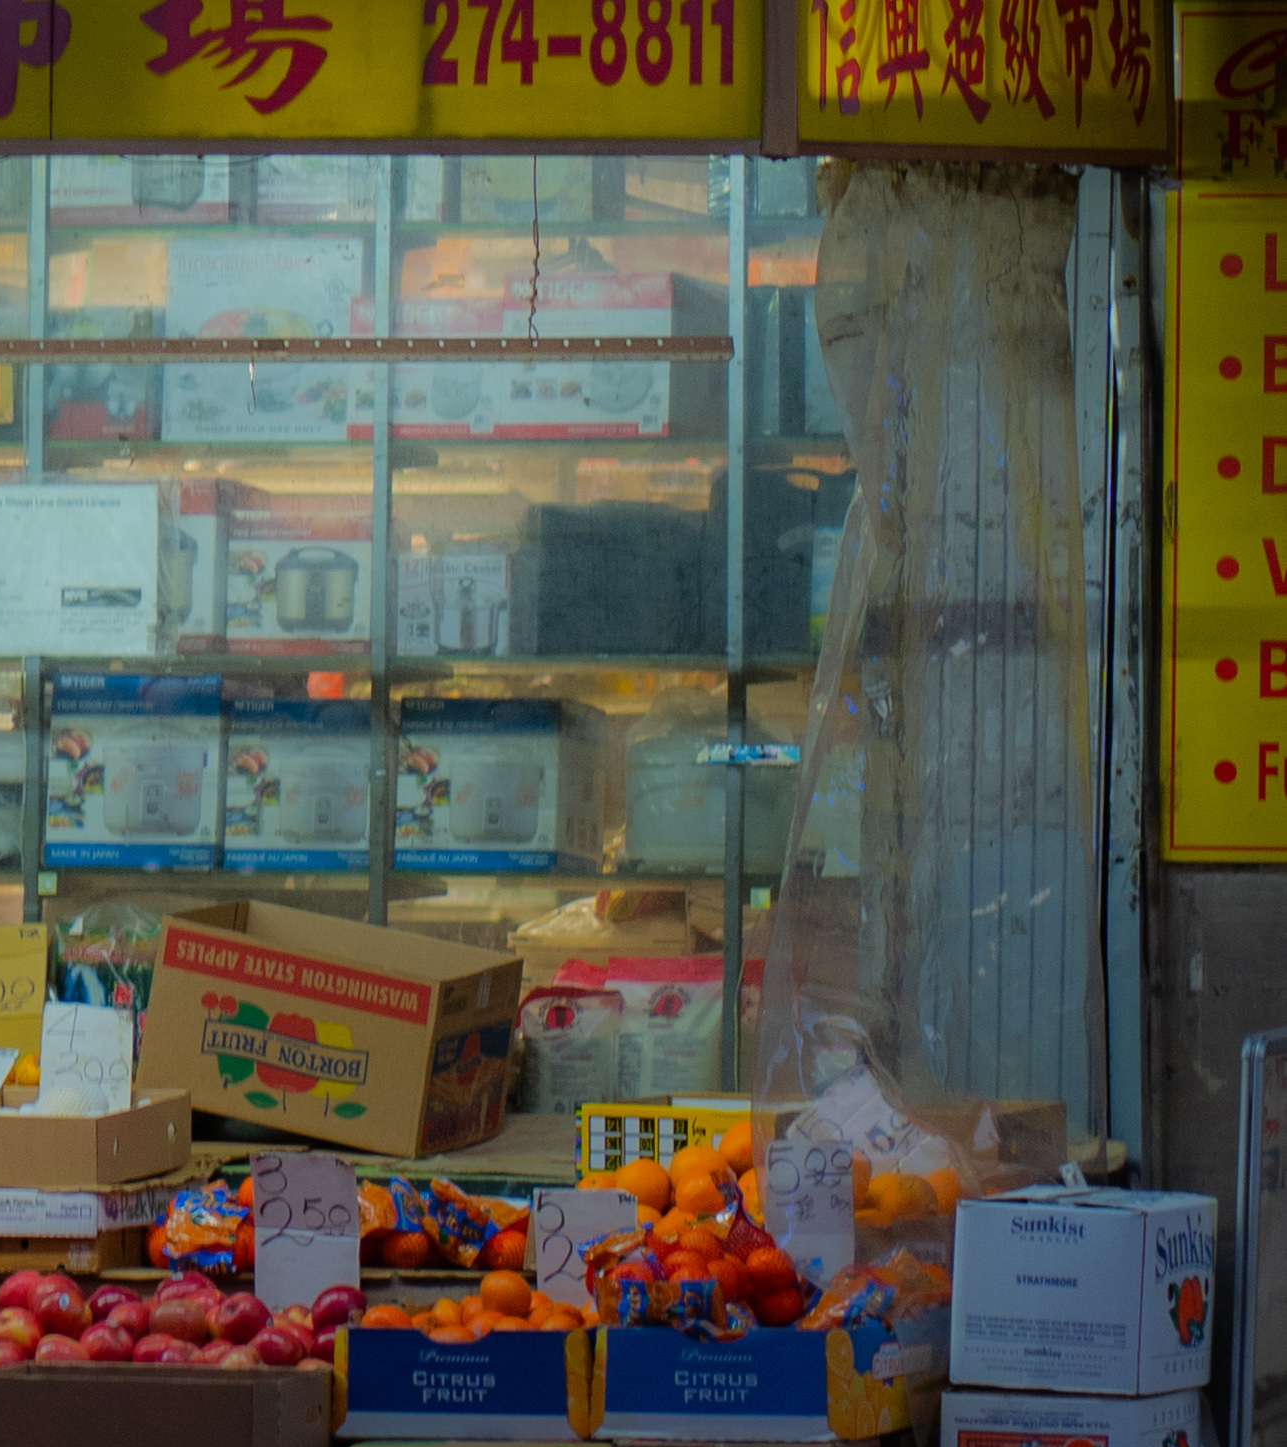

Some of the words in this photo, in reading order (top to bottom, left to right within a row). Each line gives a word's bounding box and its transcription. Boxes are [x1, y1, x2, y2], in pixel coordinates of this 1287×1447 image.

[176, 938, 239, 970] APPLES
[244, 961, 295, 983] STATE
[301, 968, 419, 1013] WASHINGTON
[207, 1030, 268, 1055] FRUIT
[278, 1047, 362, 1079] BORTON
[1011, 1216, 1086, 1238] Sunkist
[1016, 1274, 1078, 1289] STRATHMORE
[412, 1370, 496, 1388] CITRUS
[674, 1370, 758, 1388] CITRUS
[422, 1388, 487, 1403] FRUIT
[684, 1388, 750, 1404] FRUIT
